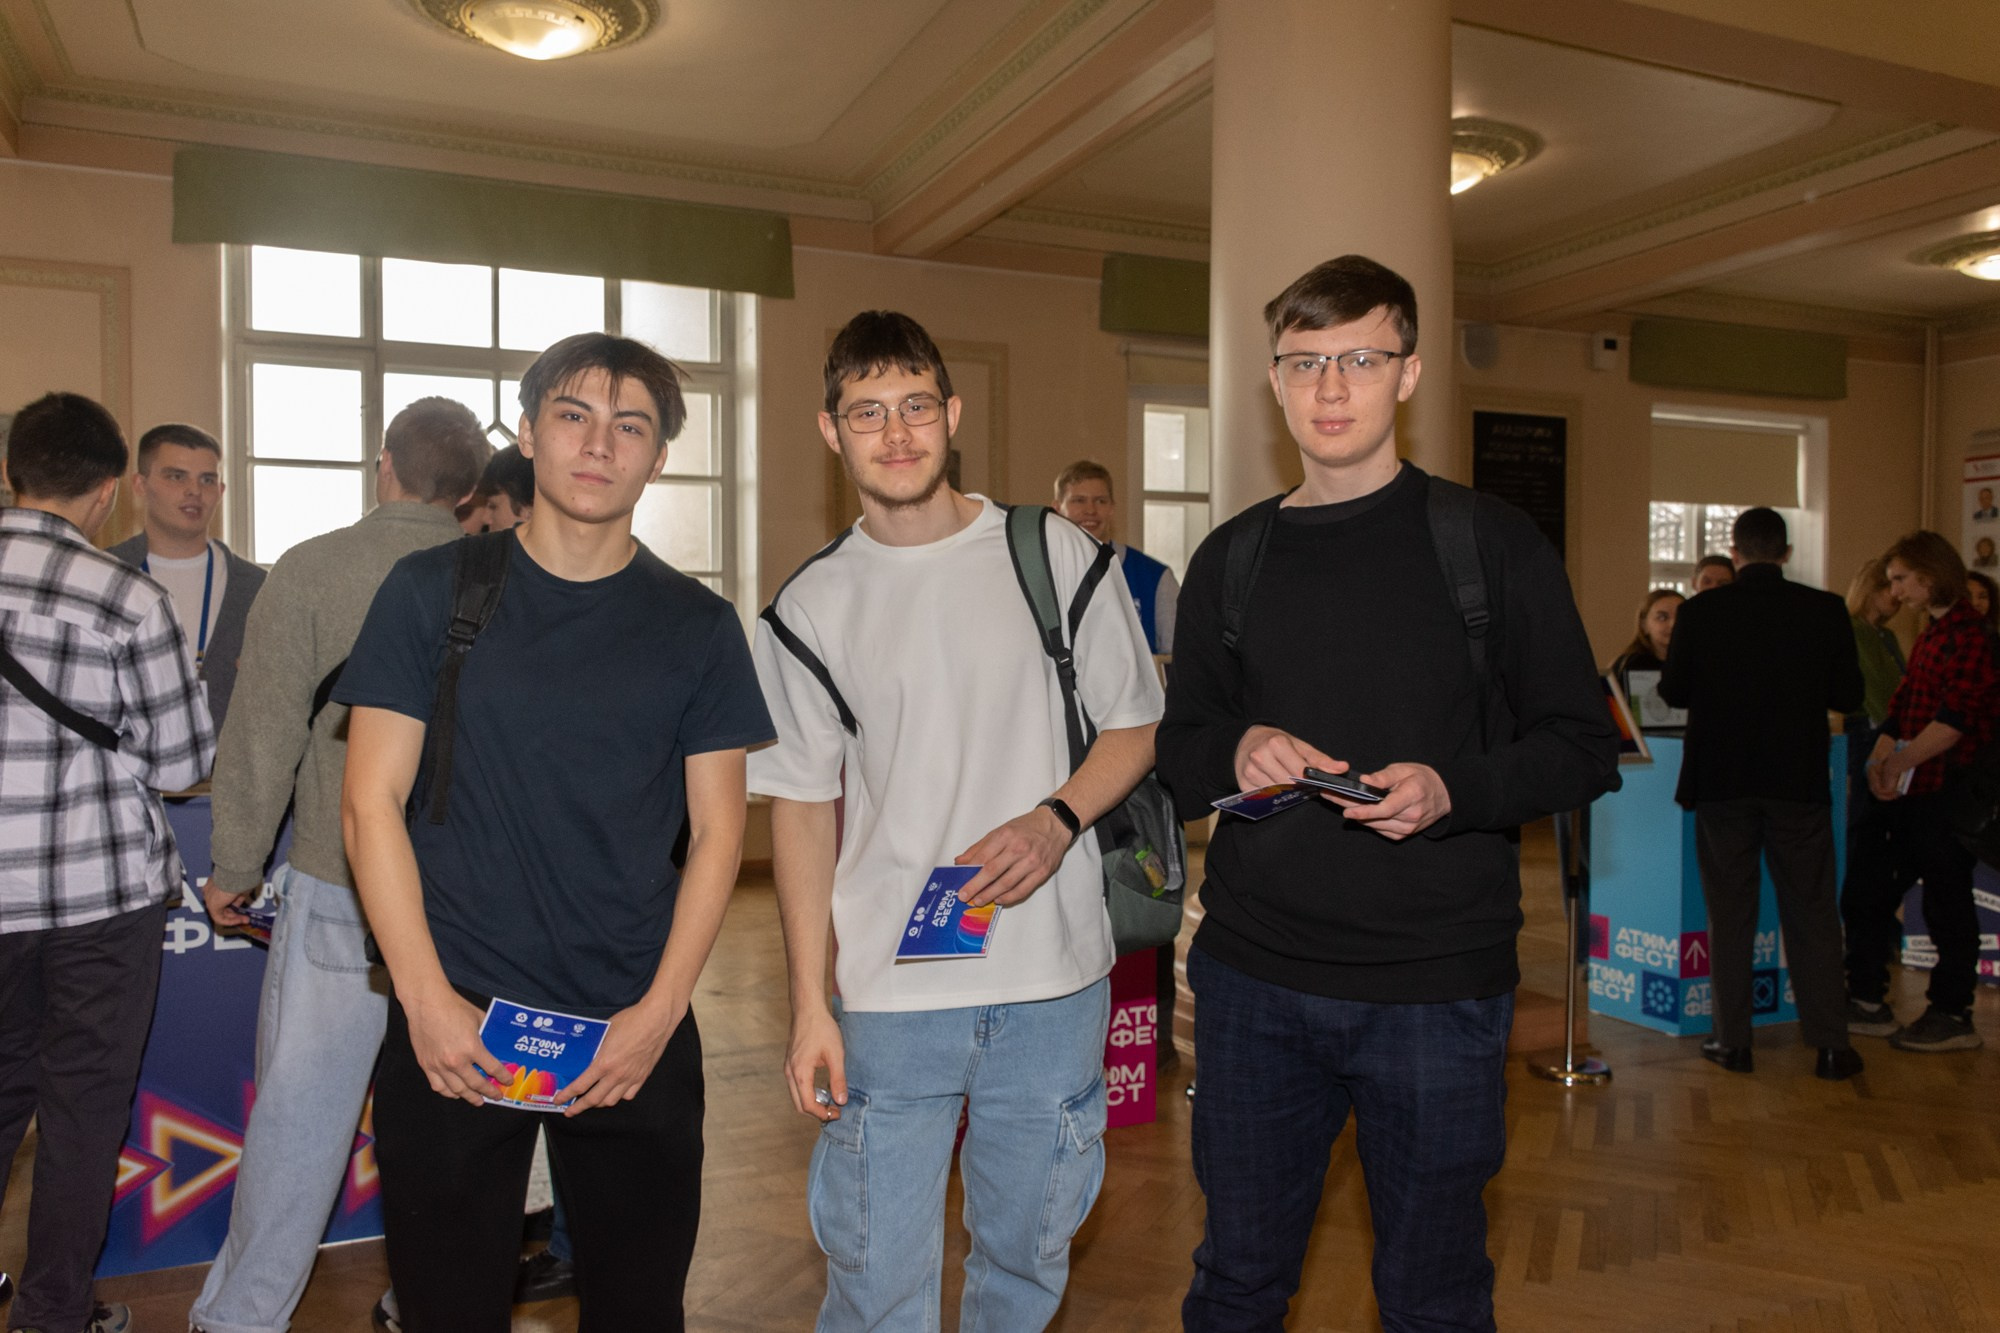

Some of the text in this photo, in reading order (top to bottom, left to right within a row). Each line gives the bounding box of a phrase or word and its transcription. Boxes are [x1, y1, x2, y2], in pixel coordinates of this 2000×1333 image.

[1615, 943, 1679, 970] ФЕСТ
[1588, 979, 1635, 1003] ЕСТ
[1110, 1025, 1157, 1048] ФЕ
[514, 1042, 563, 1059] ФЕСТ
